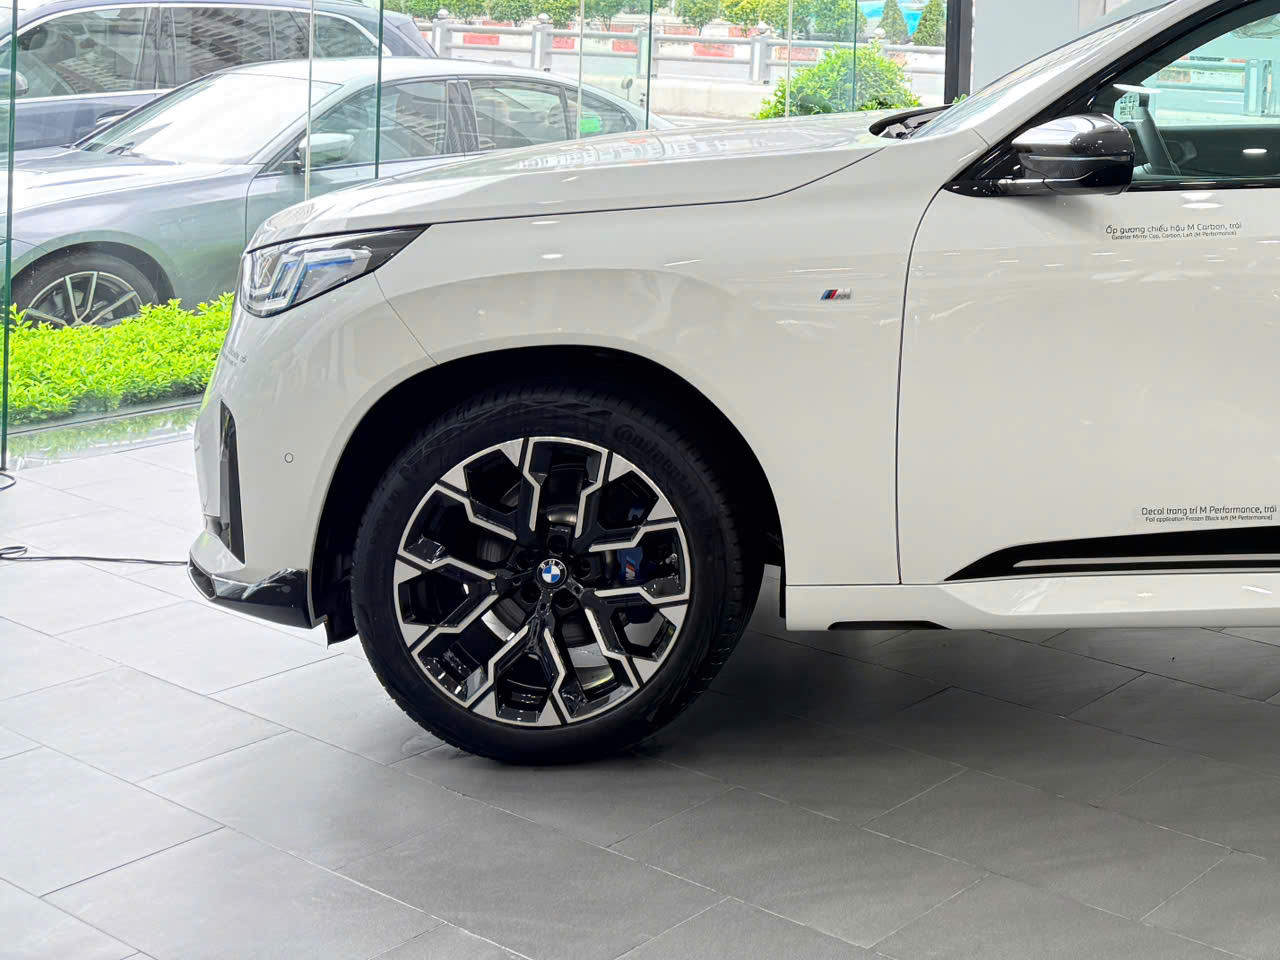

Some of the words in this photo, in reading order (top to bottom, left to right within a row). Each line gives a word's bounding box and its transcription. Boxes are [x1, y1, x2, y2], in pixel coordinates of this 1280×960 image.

[1147, 224, 1168, 233] chiếu
[1197, 223, 1228, 231] Carbon,
[1167, 507, 1188, 516] trang
[1200, 506, 1207, 514] M
[1210, 505, 1262, 514] Performance,
